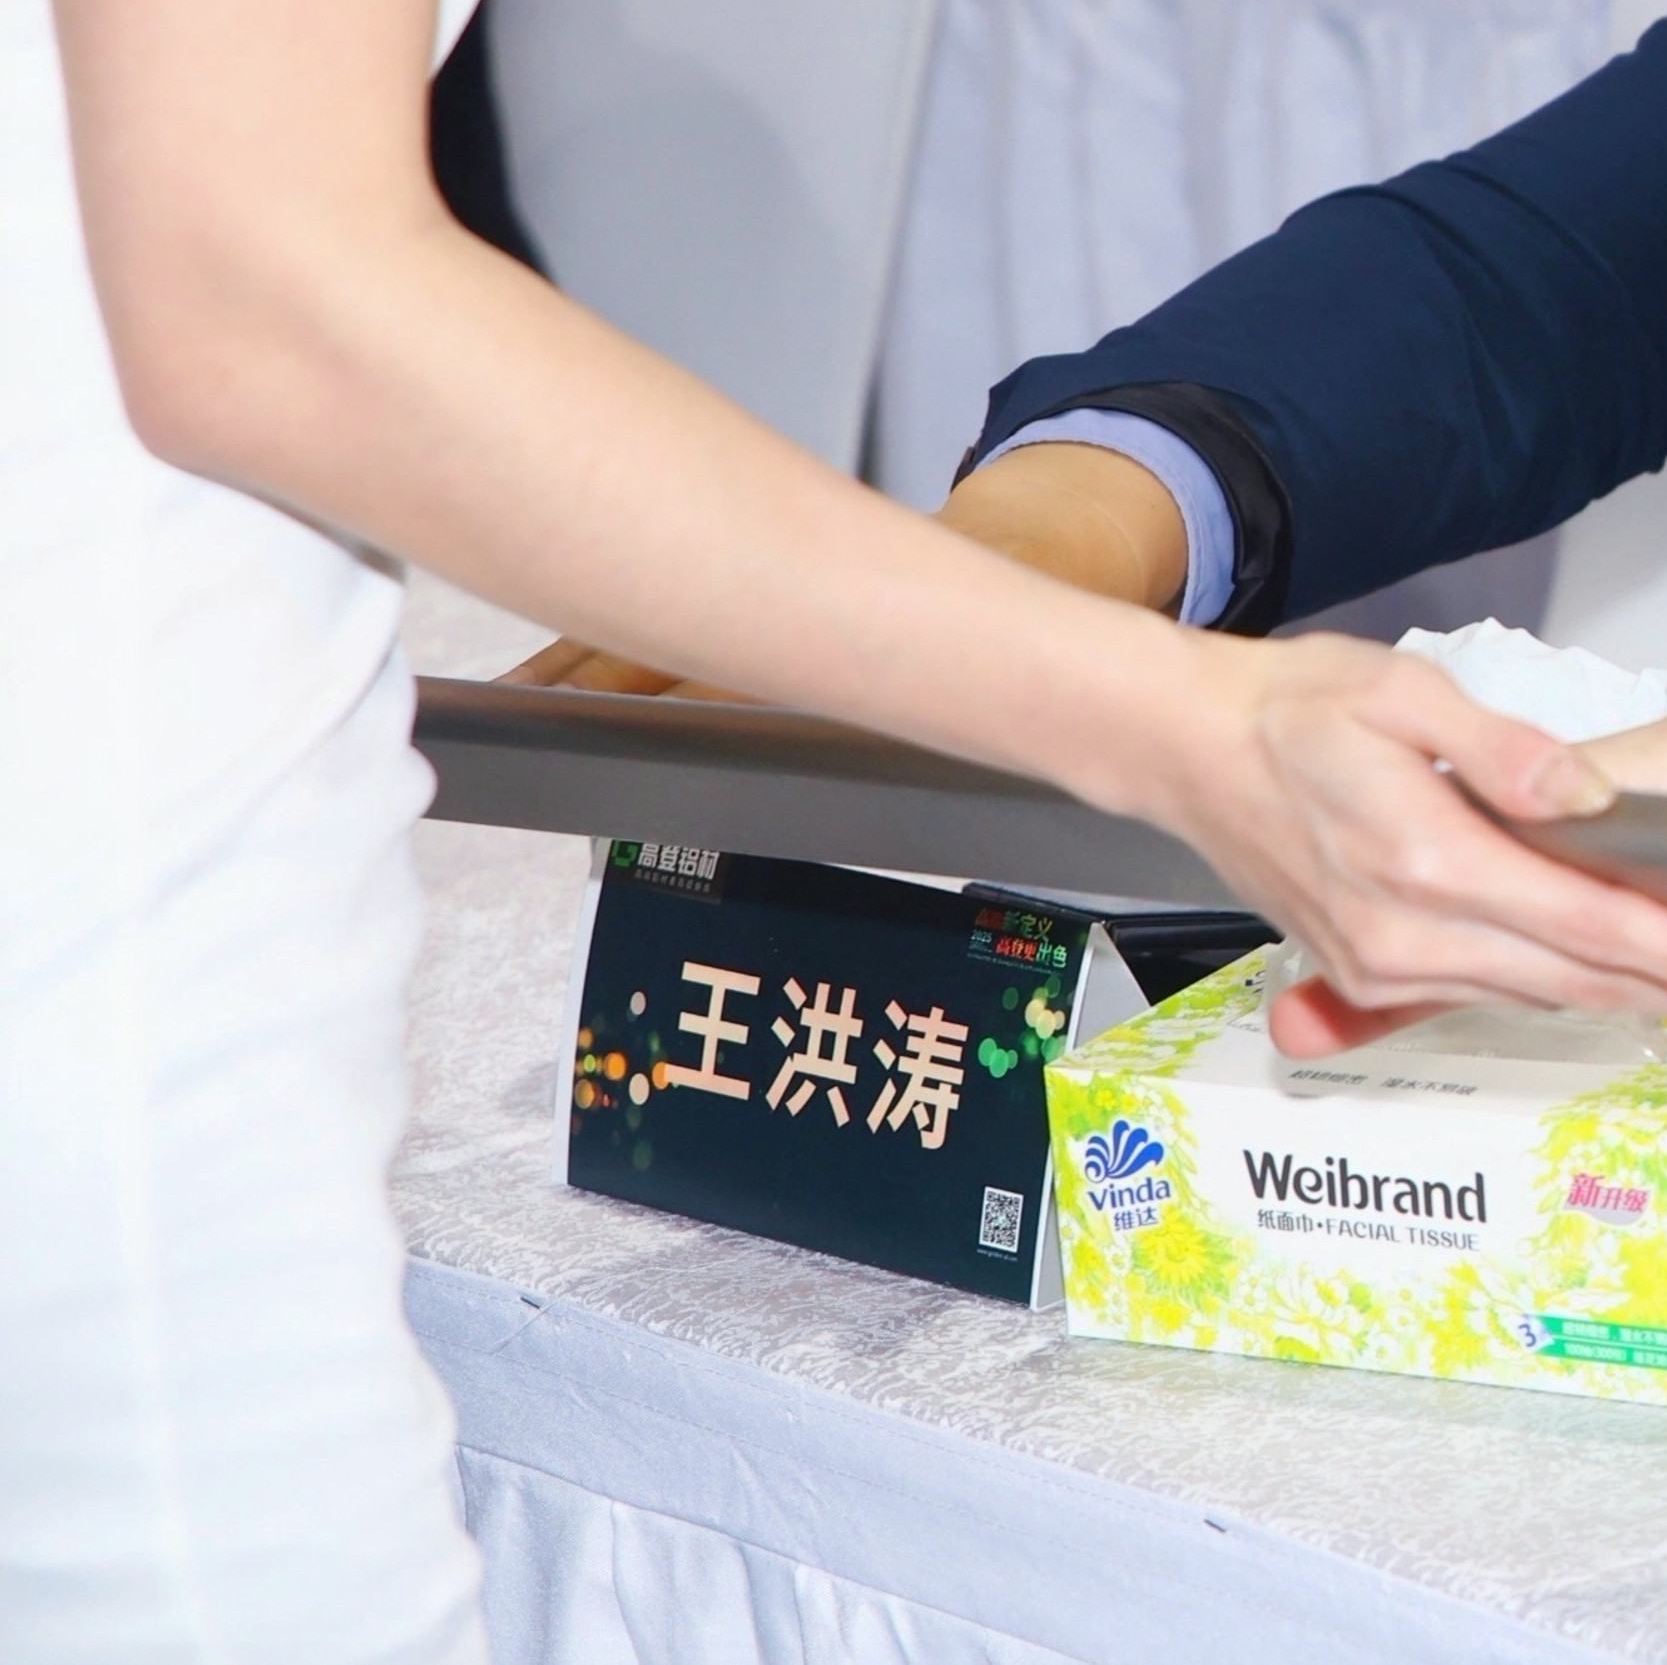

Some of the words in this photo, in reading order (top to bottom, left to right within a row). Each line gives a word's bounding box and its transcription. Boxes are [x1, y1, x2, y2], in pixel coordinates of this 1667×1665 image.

[638, 843, 720, 880] 高登铝材
[663, 961, 969, 1150] 王洪涛
[1243, 1149, 1487, 1223] Weibrand
[1567, 1172, 1648, 1213] 新升级
[1114, 1207, 1159, 1231] 维达
[1406, 1227, 1480, 1252] TISSUE
